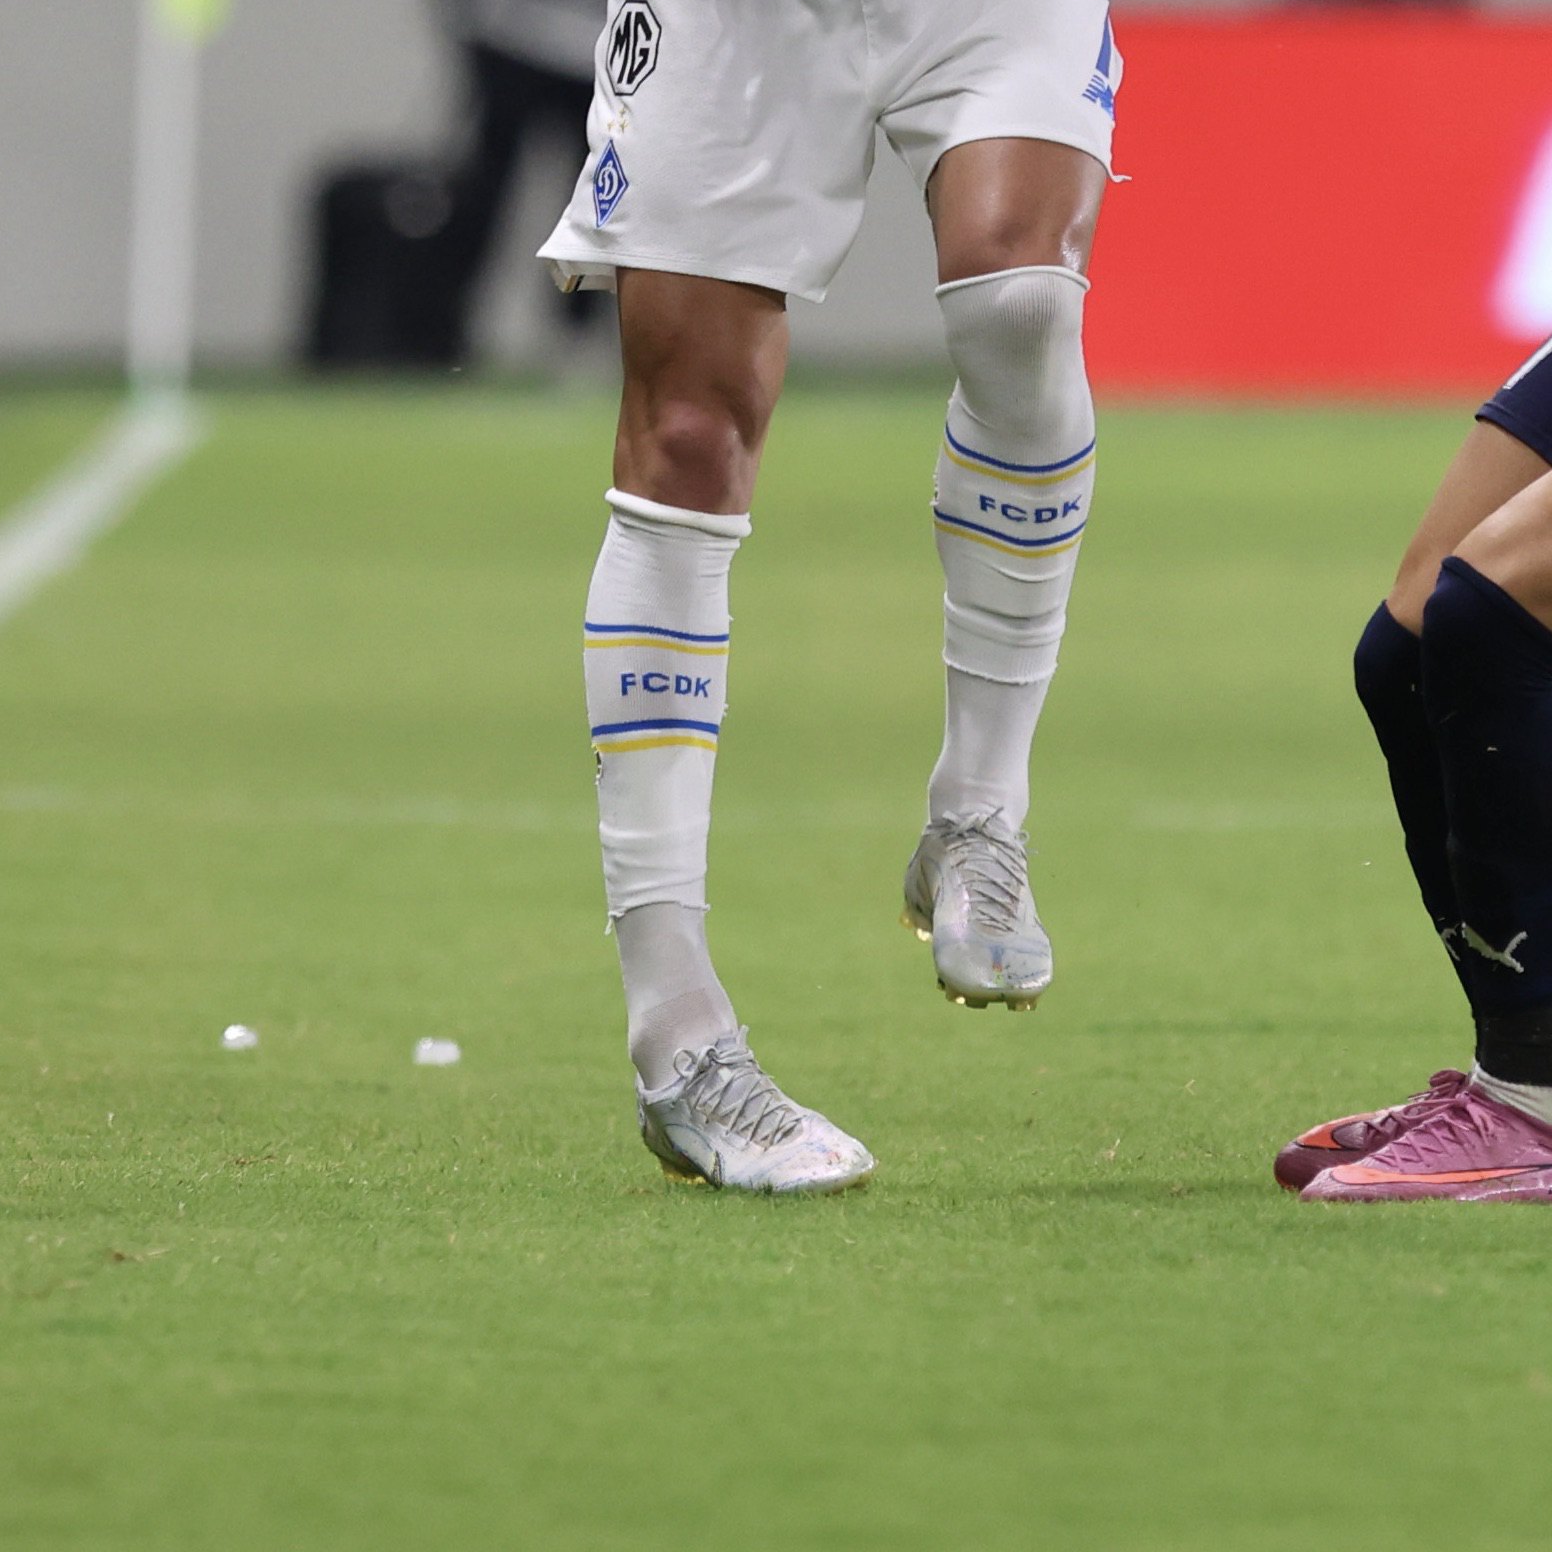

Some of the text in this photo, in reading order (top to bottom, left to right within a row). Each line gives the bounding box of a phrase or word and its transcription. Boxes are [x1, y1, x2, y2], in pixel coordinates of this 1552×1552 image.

[609, 11, 653, 85] MG
[979, 494, 1083, 524] FCDK
[620, 672, 712, 698] FCDK
